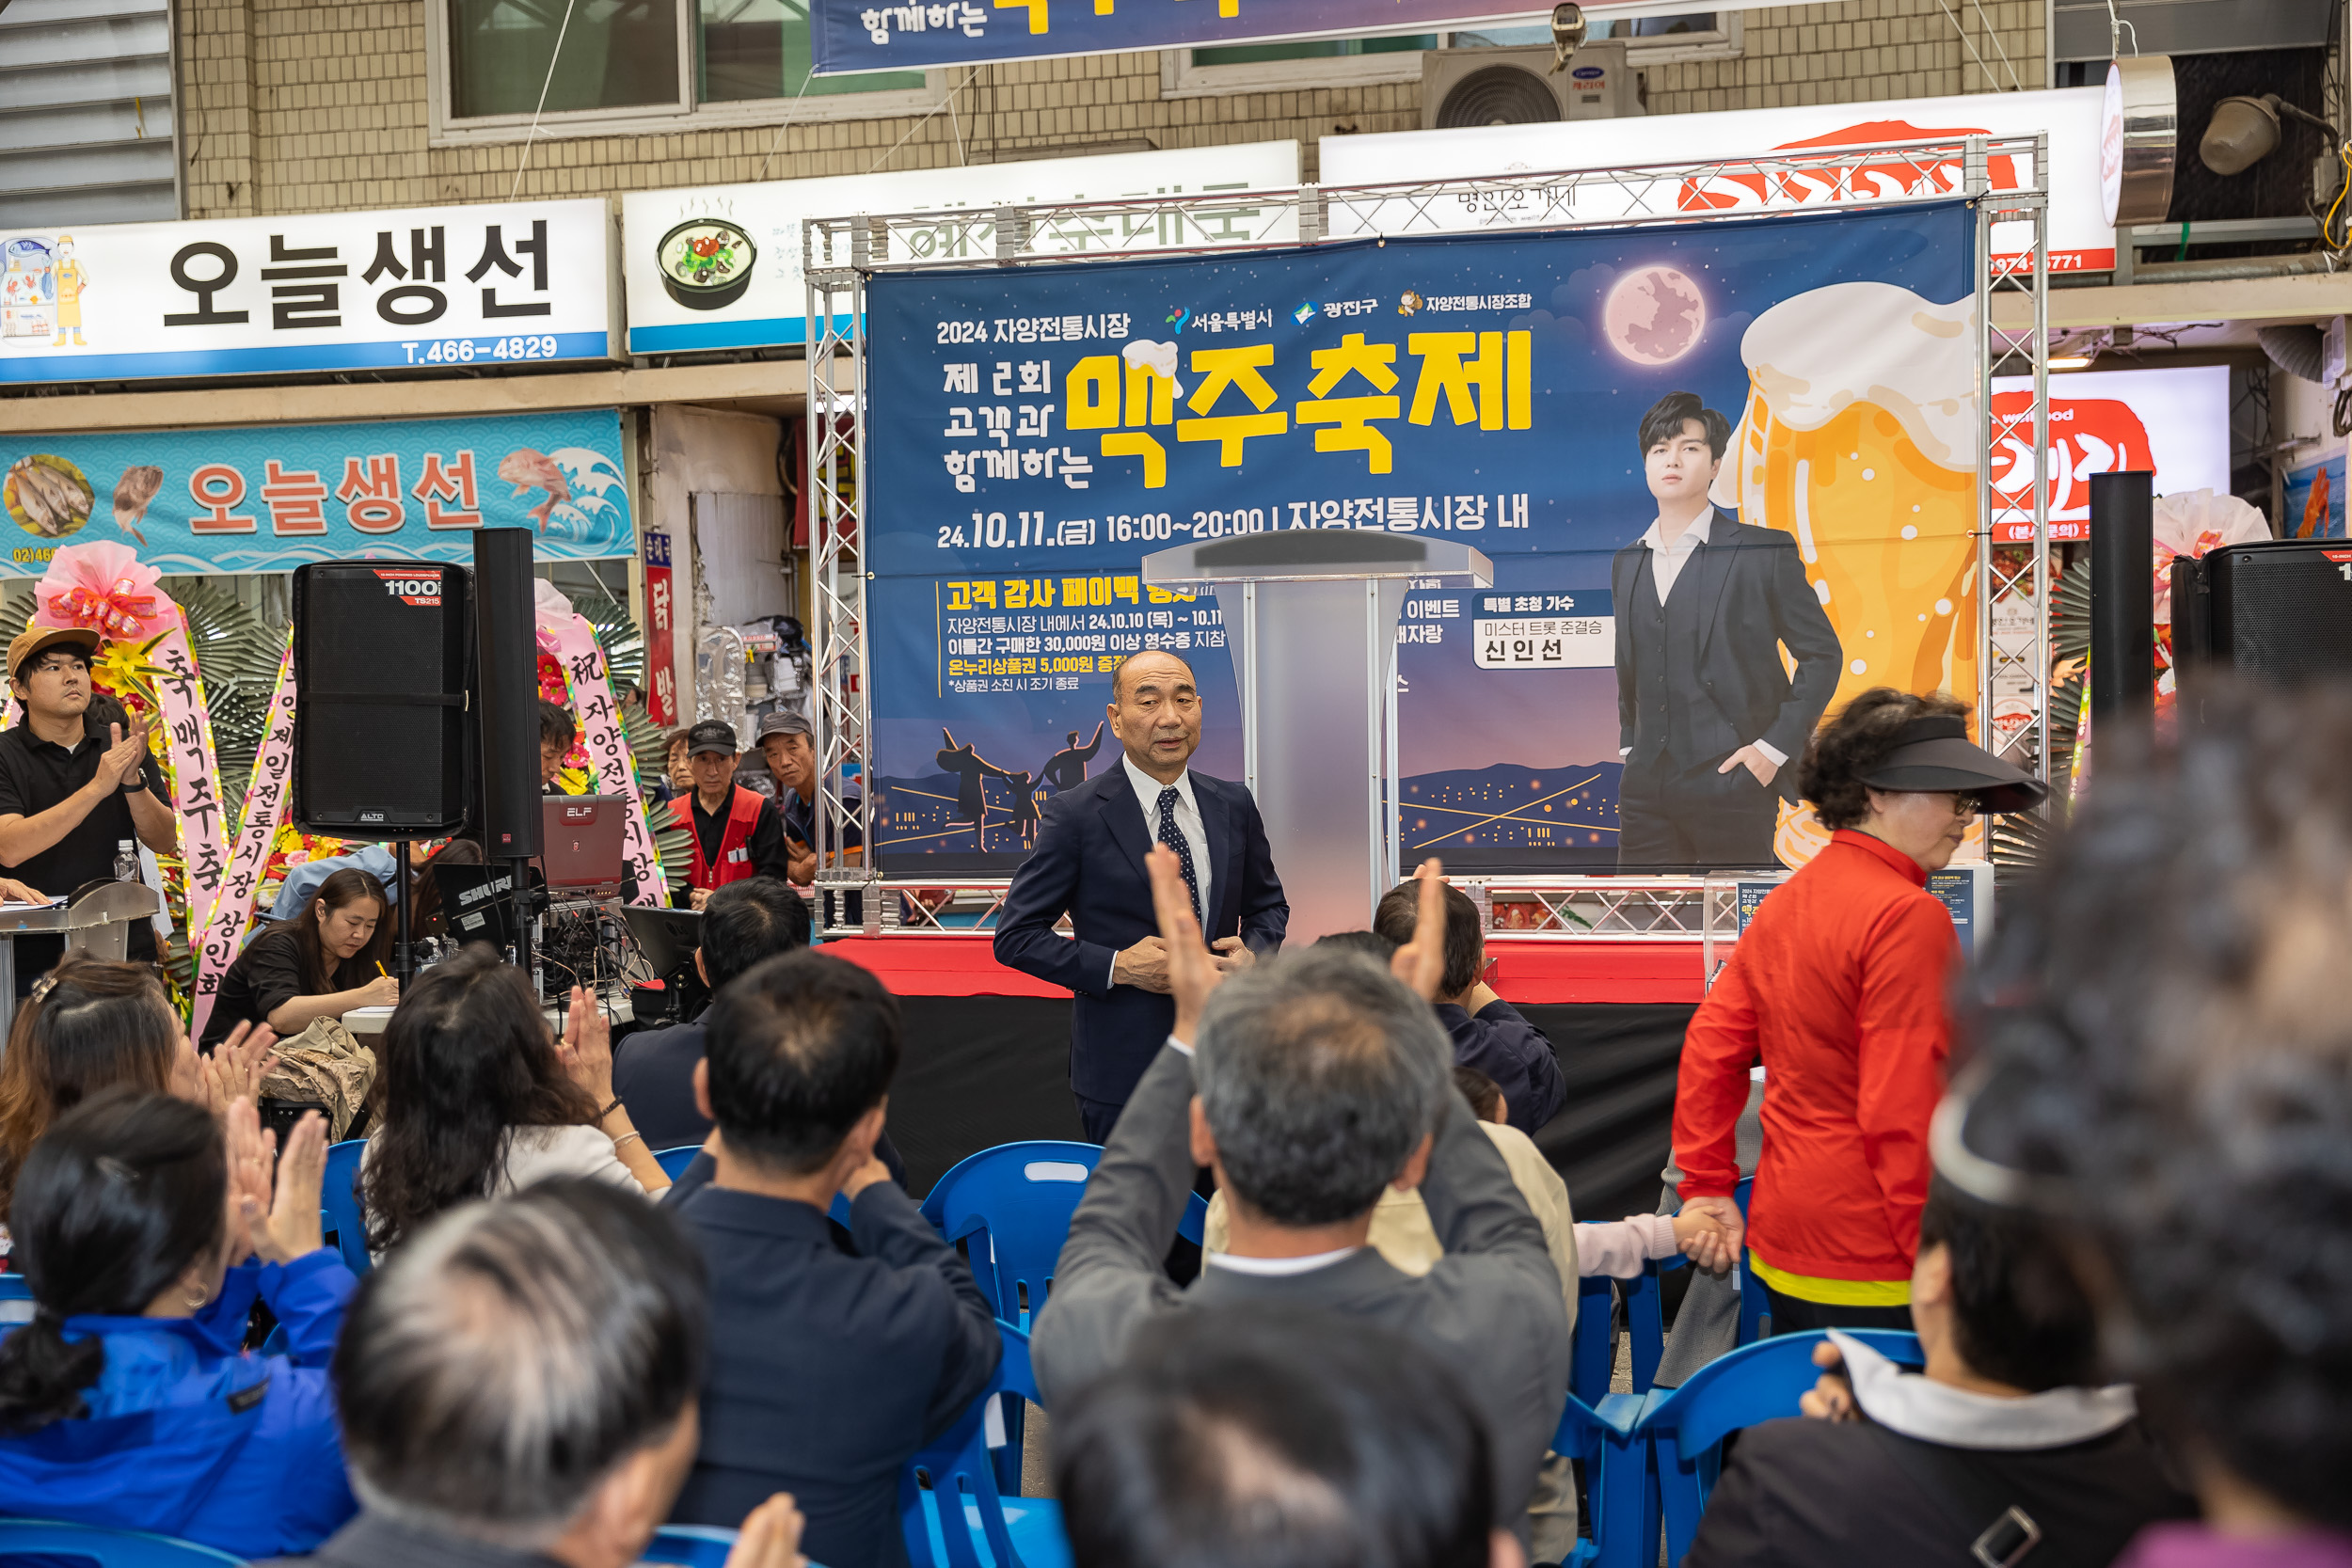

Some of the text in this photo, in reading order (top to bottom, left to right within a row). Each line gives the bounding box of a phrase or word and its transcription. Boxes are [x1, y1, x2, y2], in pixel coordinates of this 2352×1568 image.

[861, 0, 988, 45] 함께하는
[164, 219, 551, 330] 오늘생선
[1323, 299, 1378, 318] 광진구
[1425, 293, 1532, 313] 자양전통시장조합
[937, 312, 1132, 344] 2024 자양전통시장
[1191, 309, 1273, 333] 서울특별시
[402, 335, 558, 366] T.466-4829
[944, 362, 979, 393] 제
[944, 404, 1056, 448] 고객과
[944, 446, 1093, 493] 함께하는
[188, 449, 485, 537] 오늘생선
[1287, 494, 1489, 532] 자양전통시장
[1497, 493, 1529, 530] 내
[385, 580, 438, 595] 1100
[946, 580, 997, 610] 고객
[1004, 578, 1056, 609] 감사
[1061, 576, 1139, 607] 페이백
[1406, 599, 1460, 619] 이벤트
[1484, 595, 1575, 612] 특별 초청 가수
[947, 613, 1037, 635] 자양전통시장
[1041, 613, 1086, 632] 내에서
[1089, 612, 1144, 630] 24.10.10
[1147, 610, 1174, 629] (목)
[1485, 620, 1602, 636] 미스터 트롯 준결승
[947, 629, 1227, 656] 이틀간 구매한 30,000원 이상 영수증 지참
[570, 651, 604, 685] 祝
[948, 657, 1037, 675] 온누리상품권
[1041, 656, 1094, 673] 5,000원
[991, 677, 1013, 692] 소진
[1016, 677, 1027, 690] 시
[1030, 677, 1053, 691] 조기
[1056, 676, 1079, 690] 종료
[566, 807, 593, 817] ELF
